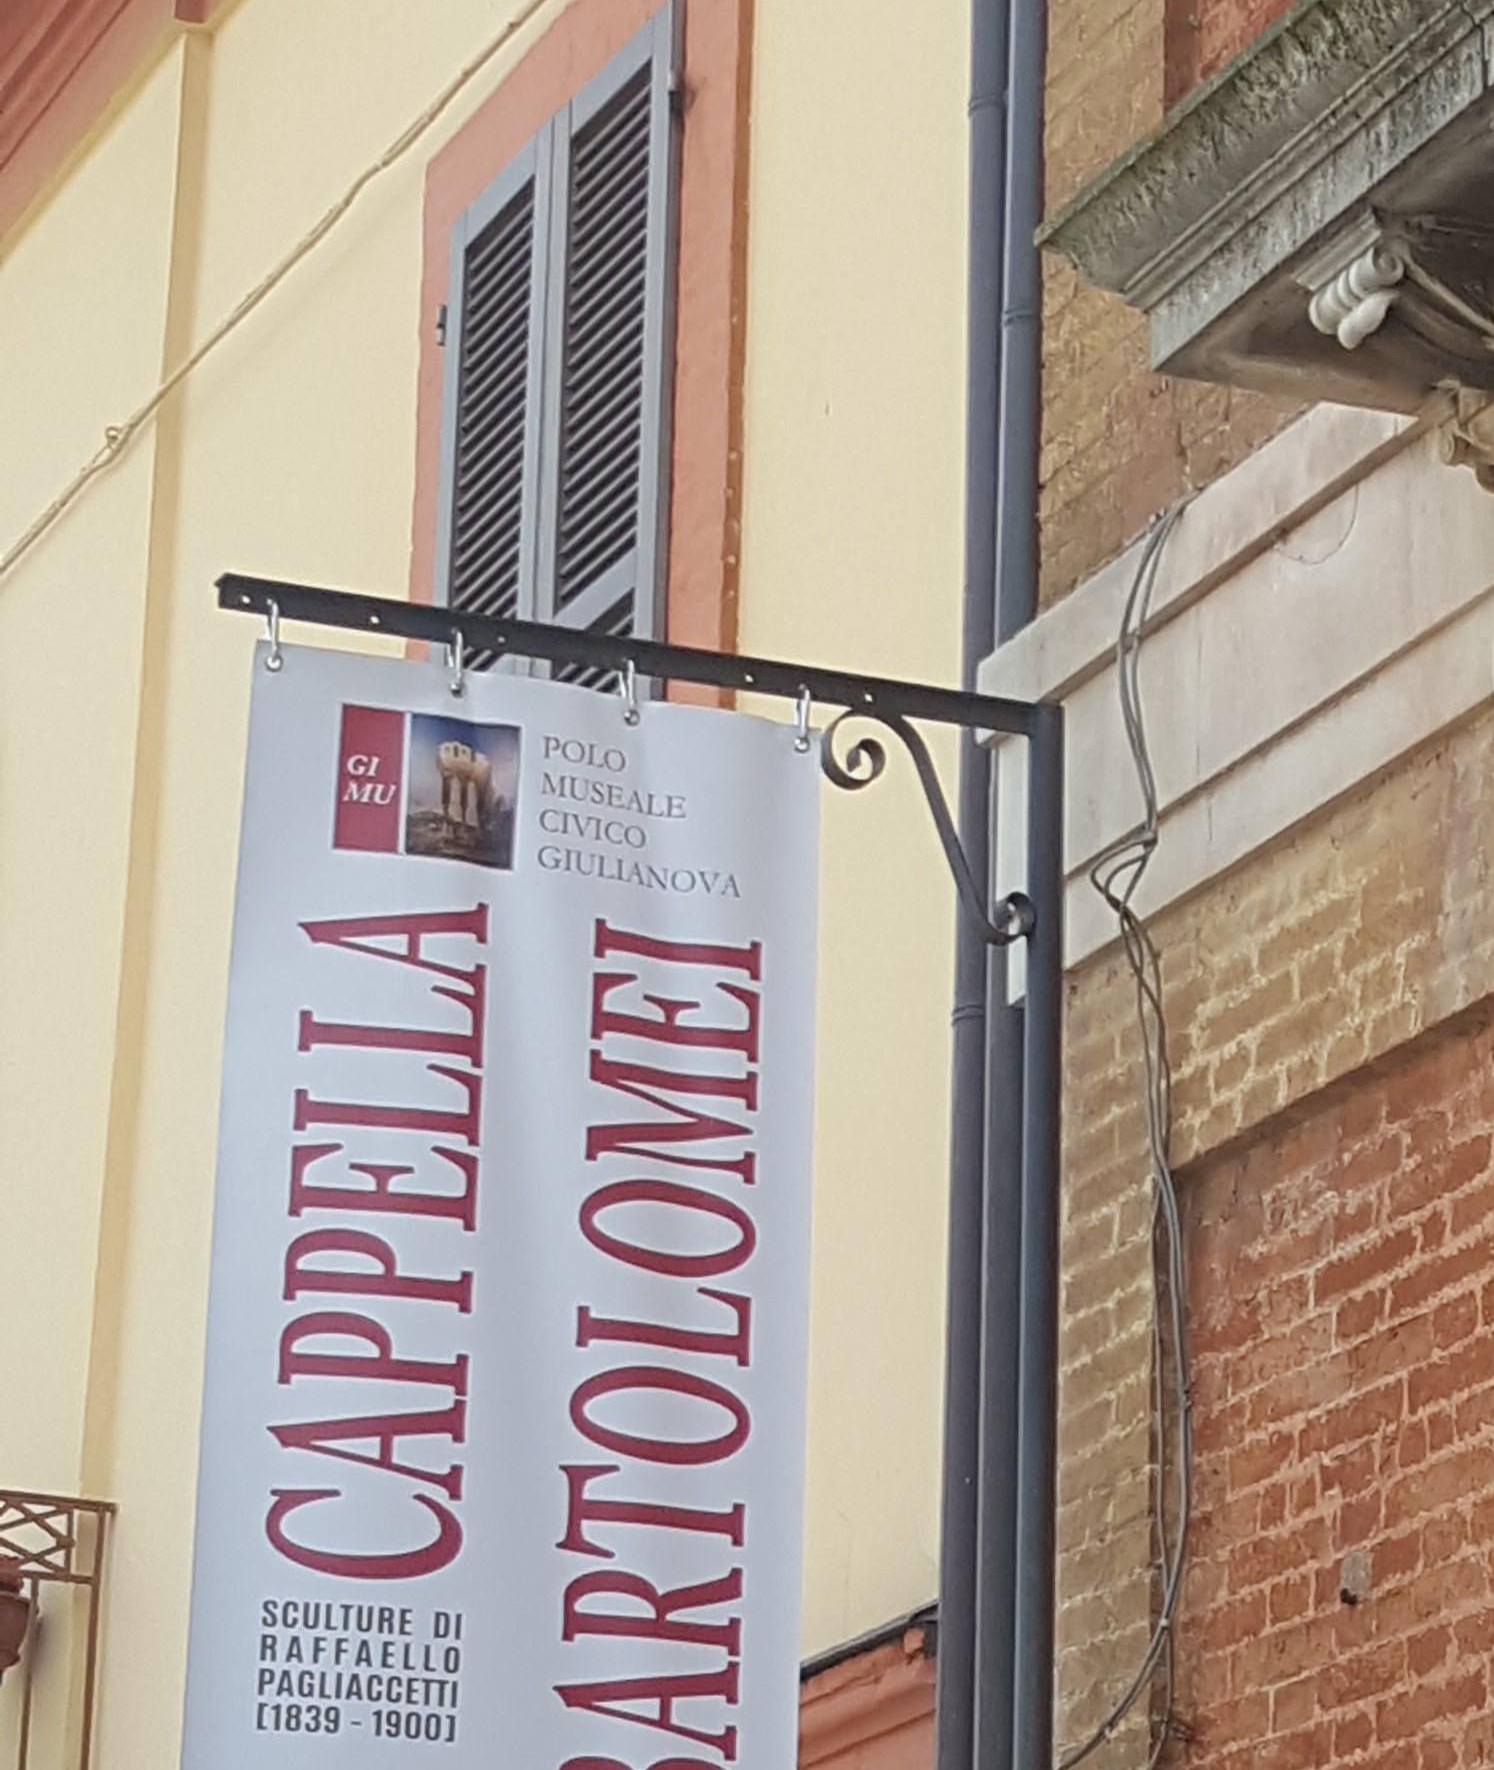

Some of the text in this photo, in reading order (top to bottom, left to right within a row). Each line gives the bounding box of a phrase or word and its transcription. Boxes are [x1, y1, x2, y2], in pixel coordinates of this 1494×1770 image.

[346, 754, 380, 777] GI
[543, 735, 626, 772] POLO
[342, 780, 396, 805] MU
[541, 772, 687, 819] MUSEALE
[538, 808, 647, 849] CIVICO
[536, 844, 741, 899] GIULIANOVA
[265, 902, 489, 1581] CAPPELLA
[261, 1599, 463, 1641] SCULTURE DI
[259, 1633, 461, 1674] RAFFAELLO
[257, 1668, 459, 1709] PAGLIACCETTI
